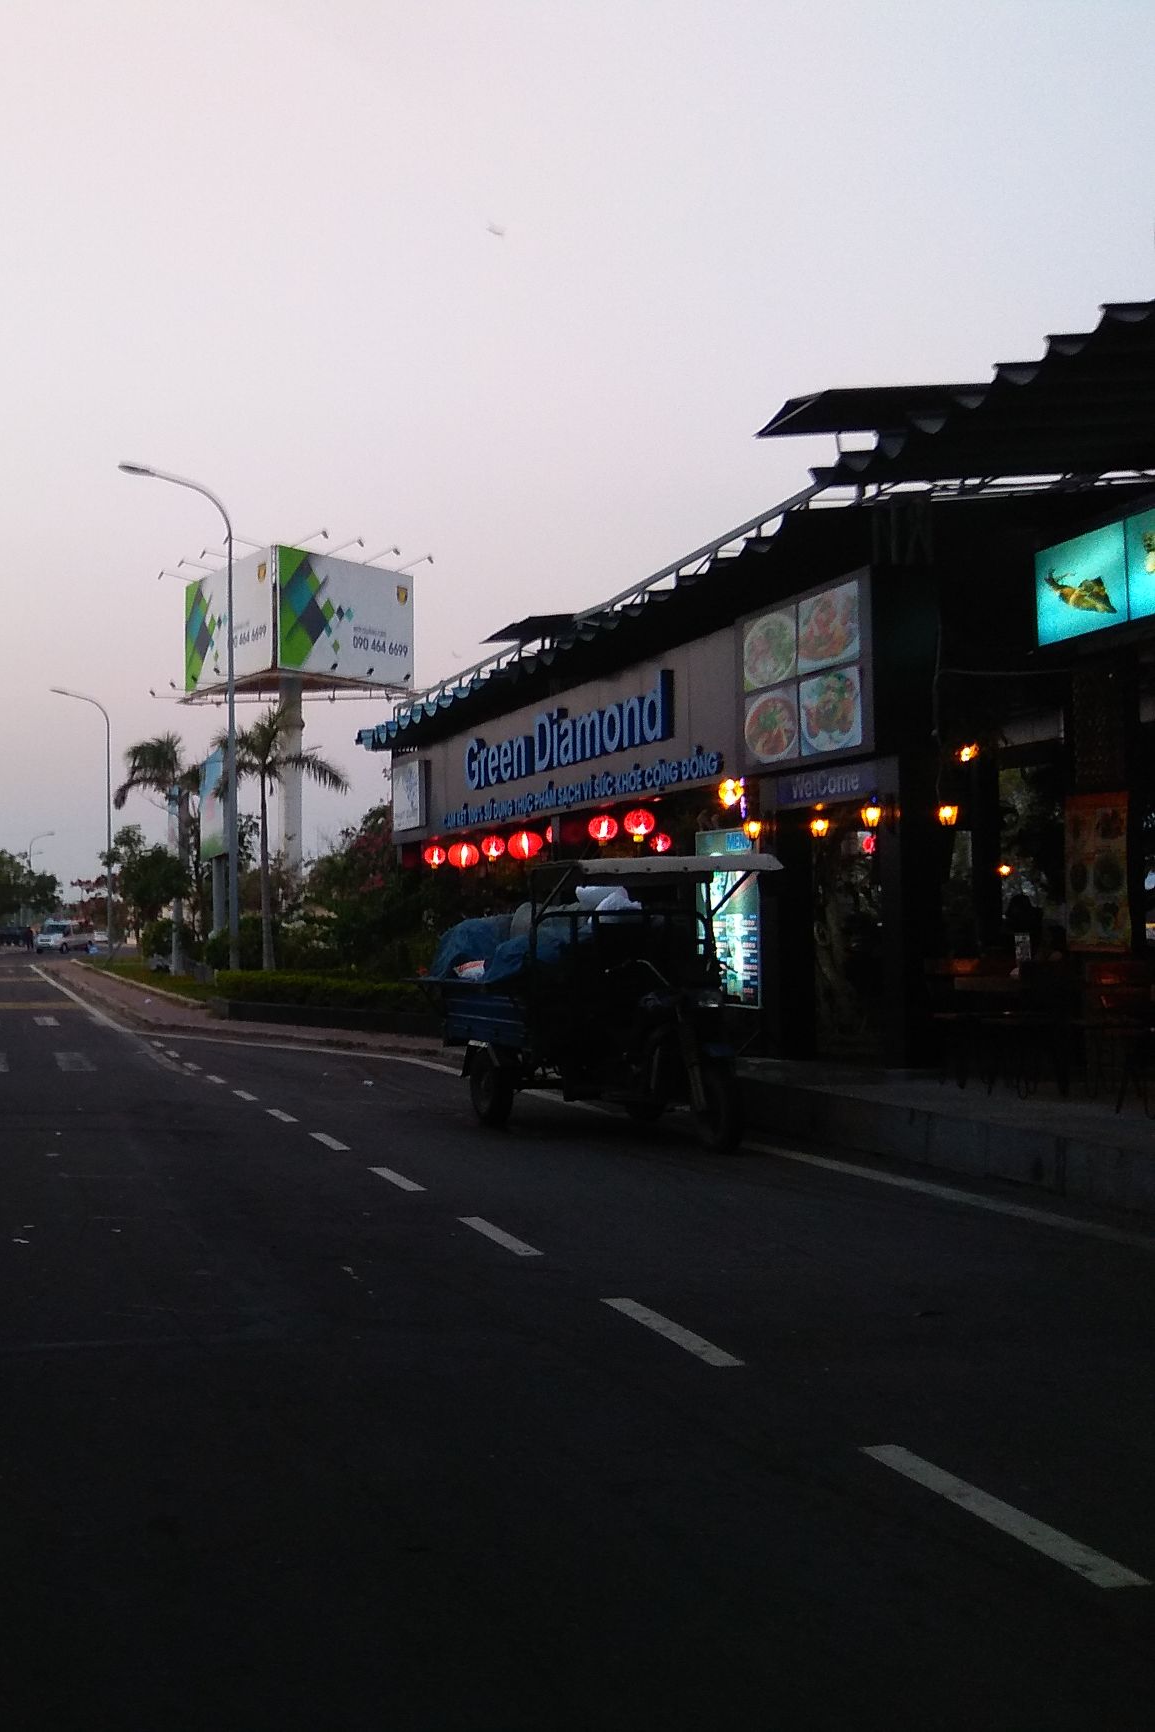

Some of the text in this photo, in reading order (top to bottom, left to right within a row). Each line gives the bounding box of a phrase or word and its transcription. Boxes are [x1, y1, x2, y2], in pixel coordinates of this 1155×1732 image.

[353, 636, 408, 657] 090 464 6699
[464, 669, 666, 790] Green Diamond
